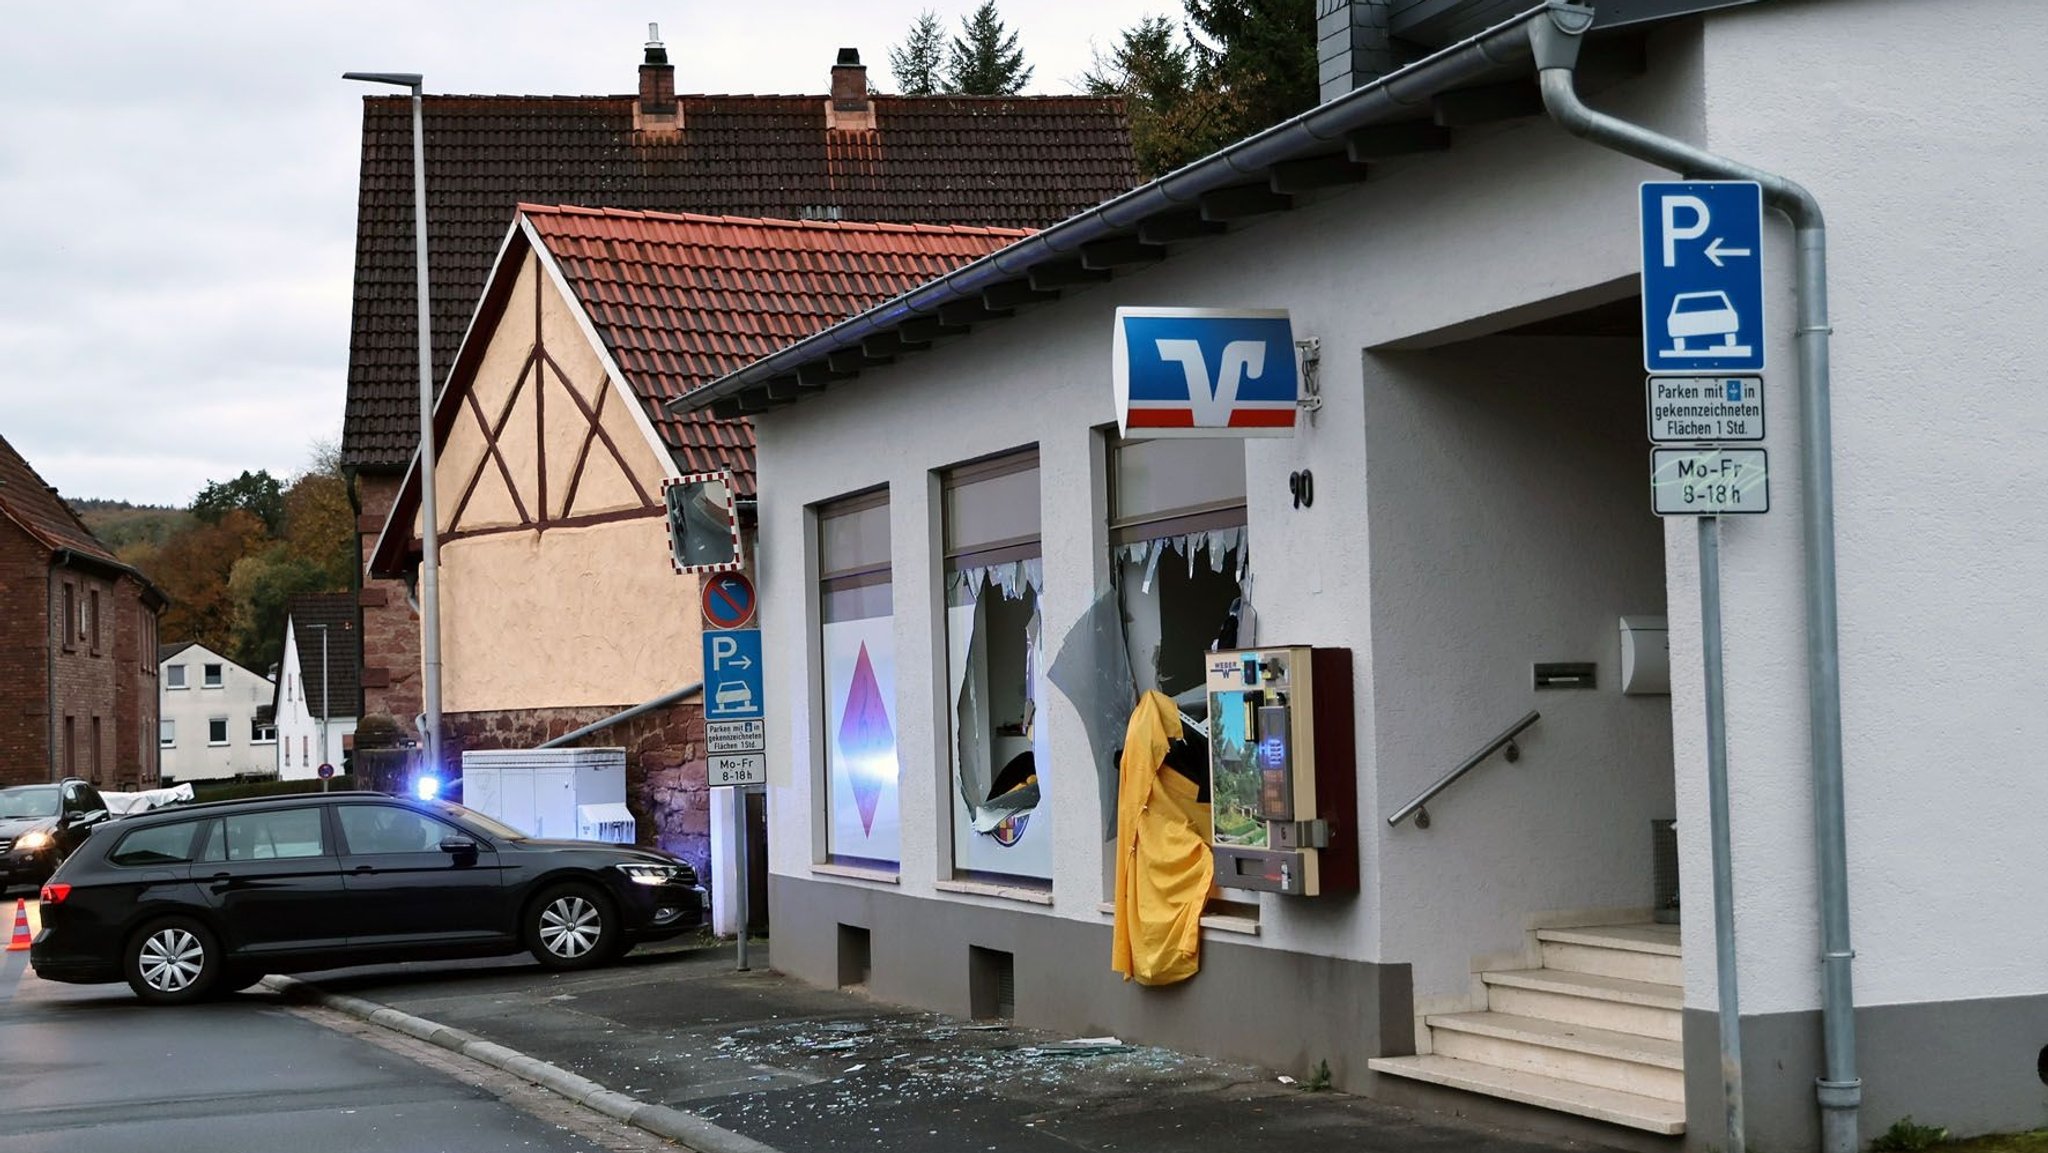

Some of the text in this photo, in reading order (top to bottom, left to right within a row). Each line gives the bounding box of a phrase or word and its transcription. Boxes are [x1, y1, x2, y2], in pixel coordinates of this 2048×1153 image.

[1661, 195, 1711, 267] P
[1658, 384, 1755, 399] Parken mit in
[1655, 402, 1759, 420] gekennzeichneten
[1667, 420, 1748, 435] Flächen 1 Std.
[1678, 459, 1743, 478] Mo-Fr
[1289, 468, 1314, 509] 90
[712, 636, 738, 671] P
[710, 725, 731, 733] Parken
[708, 732, 762, 744] gekennzeichneten
[720, 758, 754, 769] Mo-Fr
